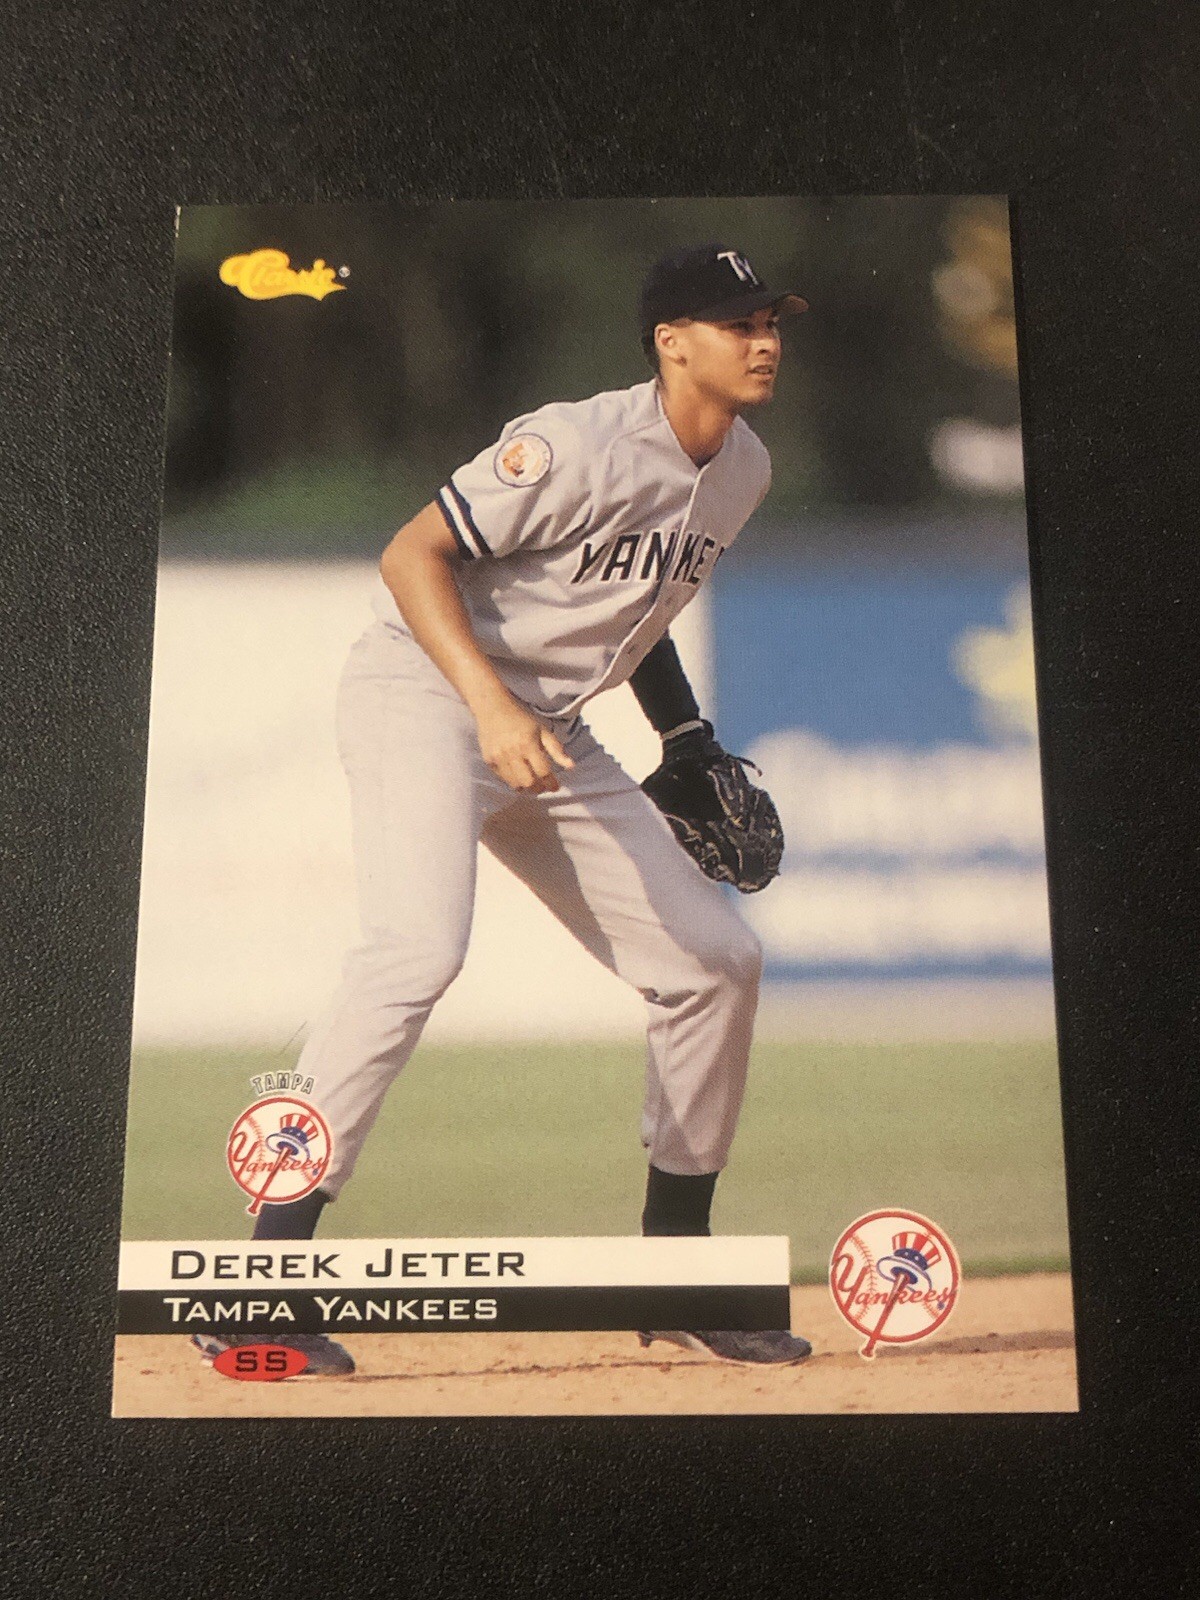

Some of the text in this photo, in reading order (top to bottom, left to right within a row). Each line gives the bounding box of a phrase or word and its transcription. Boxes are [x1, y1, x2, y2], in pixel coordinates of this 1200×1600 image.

[570, 531, 725, 584] YANKE
[252, 1073, 314, 1094] TAMPA
[230, 1131, 329, 1179] Yankees
[170, 1248, 526, 1280] DEREK JETER
[831, 1252, 957, 1310] Yankees
[163, 1296, 498, 1322] TAMPA YANKEES
[235, 1350, 288, 1373] SS
